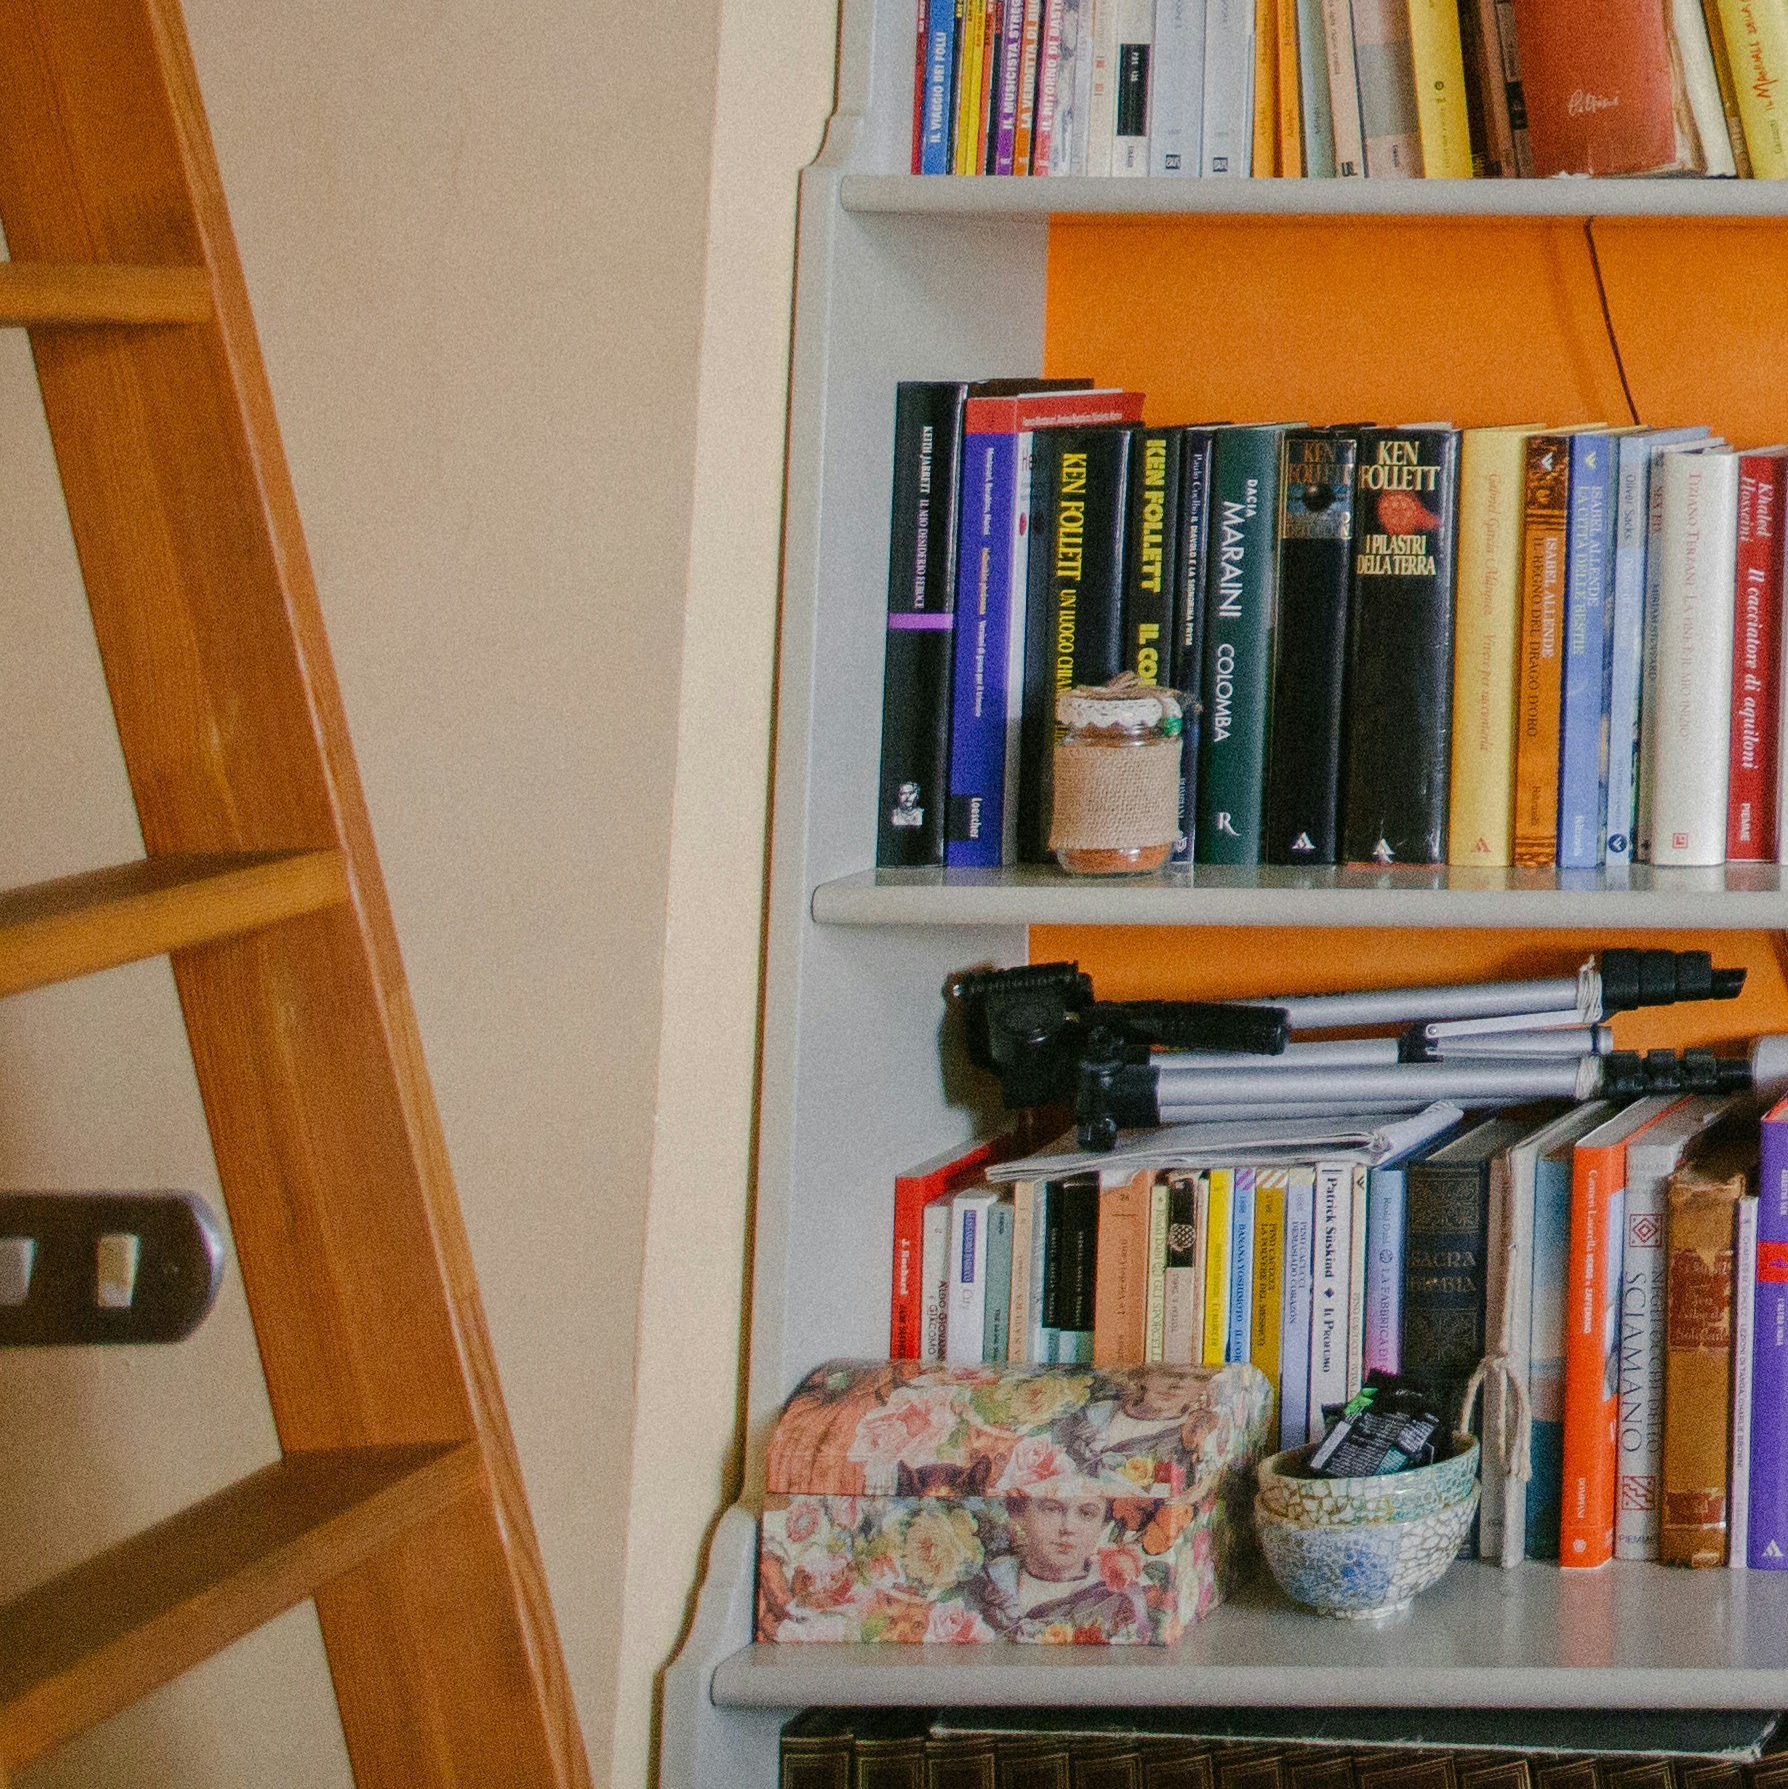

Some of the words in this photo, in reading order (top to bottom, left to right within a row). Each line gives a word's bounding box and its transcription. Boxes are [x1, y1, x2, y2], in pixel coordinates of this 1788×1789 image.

[934, 32, 946, 61] FOLLI
[1027, 26, 1037, 39] DI
[1047, 41, 1058, 54] DI
[933, 65, 944, 82] DEI
[1005, 44, 1018, 113] MUSICISTA
[1022, 44, 1036, 108] VENDETTA
[1043, 61, 1057, 116] RITORNO
[931, 86, 944, 129] VIAGGIO
[1003, 117, 1013, 129] IL
[1021, 112, 1032, 128] LA
[1042, 120, 1052, 130] IL
[930, 133, 940, 143] IL
[1061, 452, 1088, 494] KEN
[1143, 439, 1166, 486] KEN
[1377, 441, 1419, 464] KEN
[1244, 479, 1259, 518] DACIA
[1359, 465, 1440, 491] FOLLETT
[1578, 486, 1588, 503] LA
[1589, 486, 1602, 535] ISABEL
[1739, 476, 1754, 542] Hosseini
[1757, 483, 1773, 537] Khaled
[1056, 500, 1085, 581] FOLLETT
[1139, 491, 1164, 593] FOLLETT
[1216, 501, 1244, 618] MARAINI
[1373, 535, 1427, 554] PILASTRI
[1533, 537, 1543, 549] IL
[1545, 537, 1556, 586] ISABEL
[1357, 555, 1390, 575] DELLA
[1393, 555, 1436, 575] TERRA
[1530, 555, 1542, 604] REGNO
[1574, 553, 1586, 599] DELLE
[1587, 539, 1601, 607] ALLENDE
[1750, 569, 1764, 582] Il
[1061, 588, 1076, 607] UN
[1058, 609, 1075, 652] LUOGO
[1138, 622, 1159, 643] IL
[1530, 608, 1540, 637] DEL
[1542, 592, 1554, 657] ALLENDE
[1573, 604, 1585, 654] BESTIE
[1744, 587, 1760, 668] cacciatore
[1528, 642, 1539, 691] DRAGO
[1743, 674, 1759, 692] di
[1213, 643, 1235, 743] COLOMBA
[1527, 696, 1538, 737] D'ORO
[1738, 696, 1758, 769] aquiloni
[1382, 1198, 1392, 1221] Roald
[1381, 1223, 1391, 1244] Dahl
[1381, 1268, 1391, 1283] LA
[1650, 1268, 1664, 1325] NEGLI
[1378, 1287, 1390, 1345] FABBRICA
[1378, 1348, 1388, 1361] DI
[1621, 1271, 1646, 1454] SCIAMANO
[1648, 1331, 1662, 1393] OCCHI
[1646, 1398, 1661, 1452] DELLO
